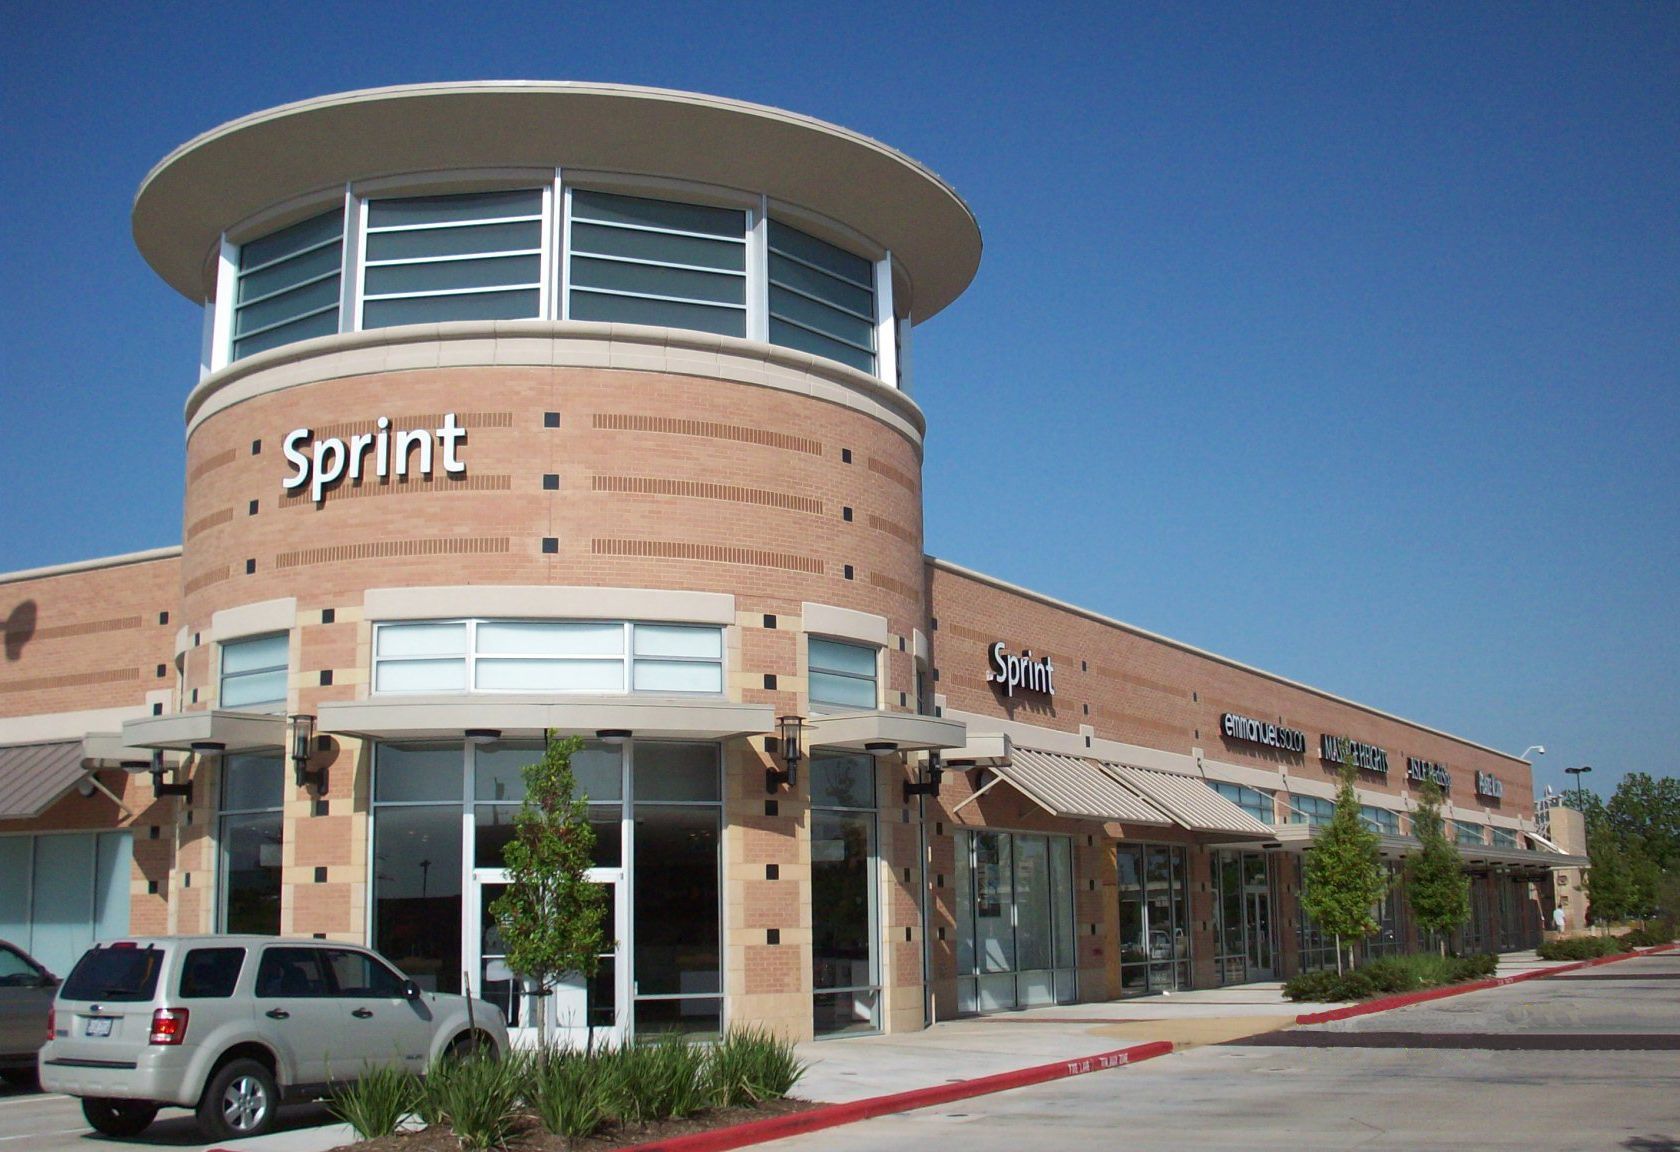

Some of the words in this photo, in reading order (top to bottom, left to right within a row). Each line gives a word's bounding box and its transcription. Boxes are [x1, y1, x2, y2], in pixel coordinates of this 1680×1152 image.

[283, 413, 465, 501] Sprint
[993, 641, 1056, 697] Sprint
[1224, 713, 1280, 747] emmanuel
